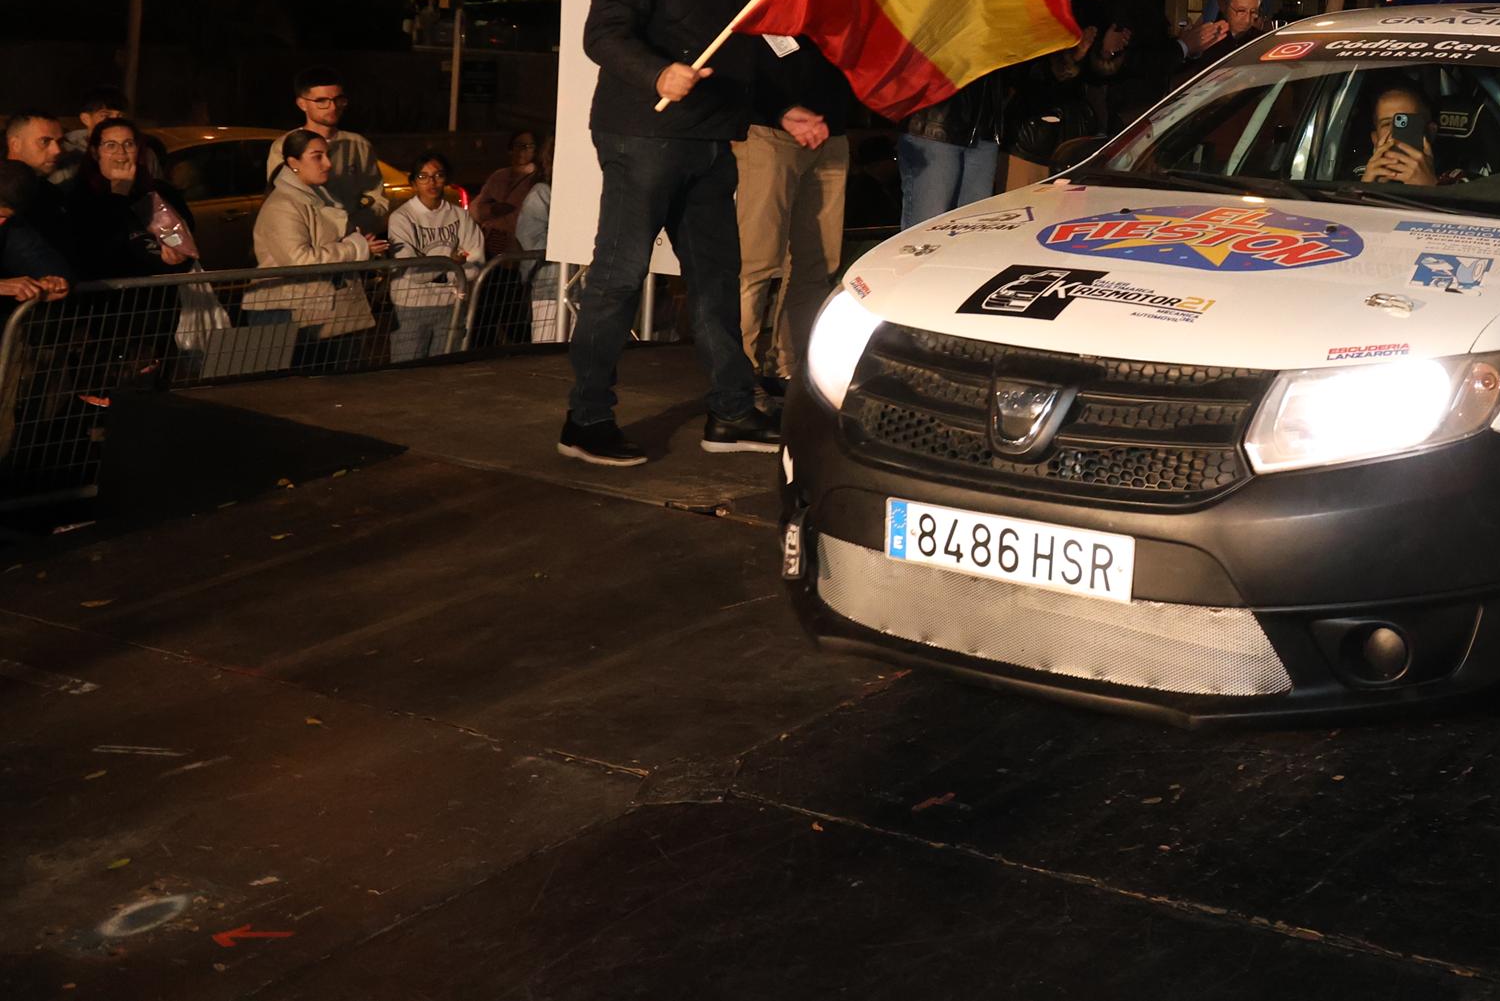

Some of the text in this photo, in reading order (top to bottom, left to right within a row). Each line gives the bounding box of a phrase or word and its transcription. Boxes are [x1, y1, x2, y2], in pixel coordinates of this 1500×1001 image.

[1325, 38, 1429, 51] Código
[1336, 50, 1476, 59] MOTORSPORT
[1439, 112, 1469, 127] OMP
[1189, 207, 1273, 229] EL
[1046, 219, 1352, 266] FIESTÓN
[1327, 350, 1409, 361] LANZAROTE
[1329, 343, 1409, 355] ESCUDERIA
[893, 535, 903, 549] E
[918, 513, 1114, 591] 8486 HSR
